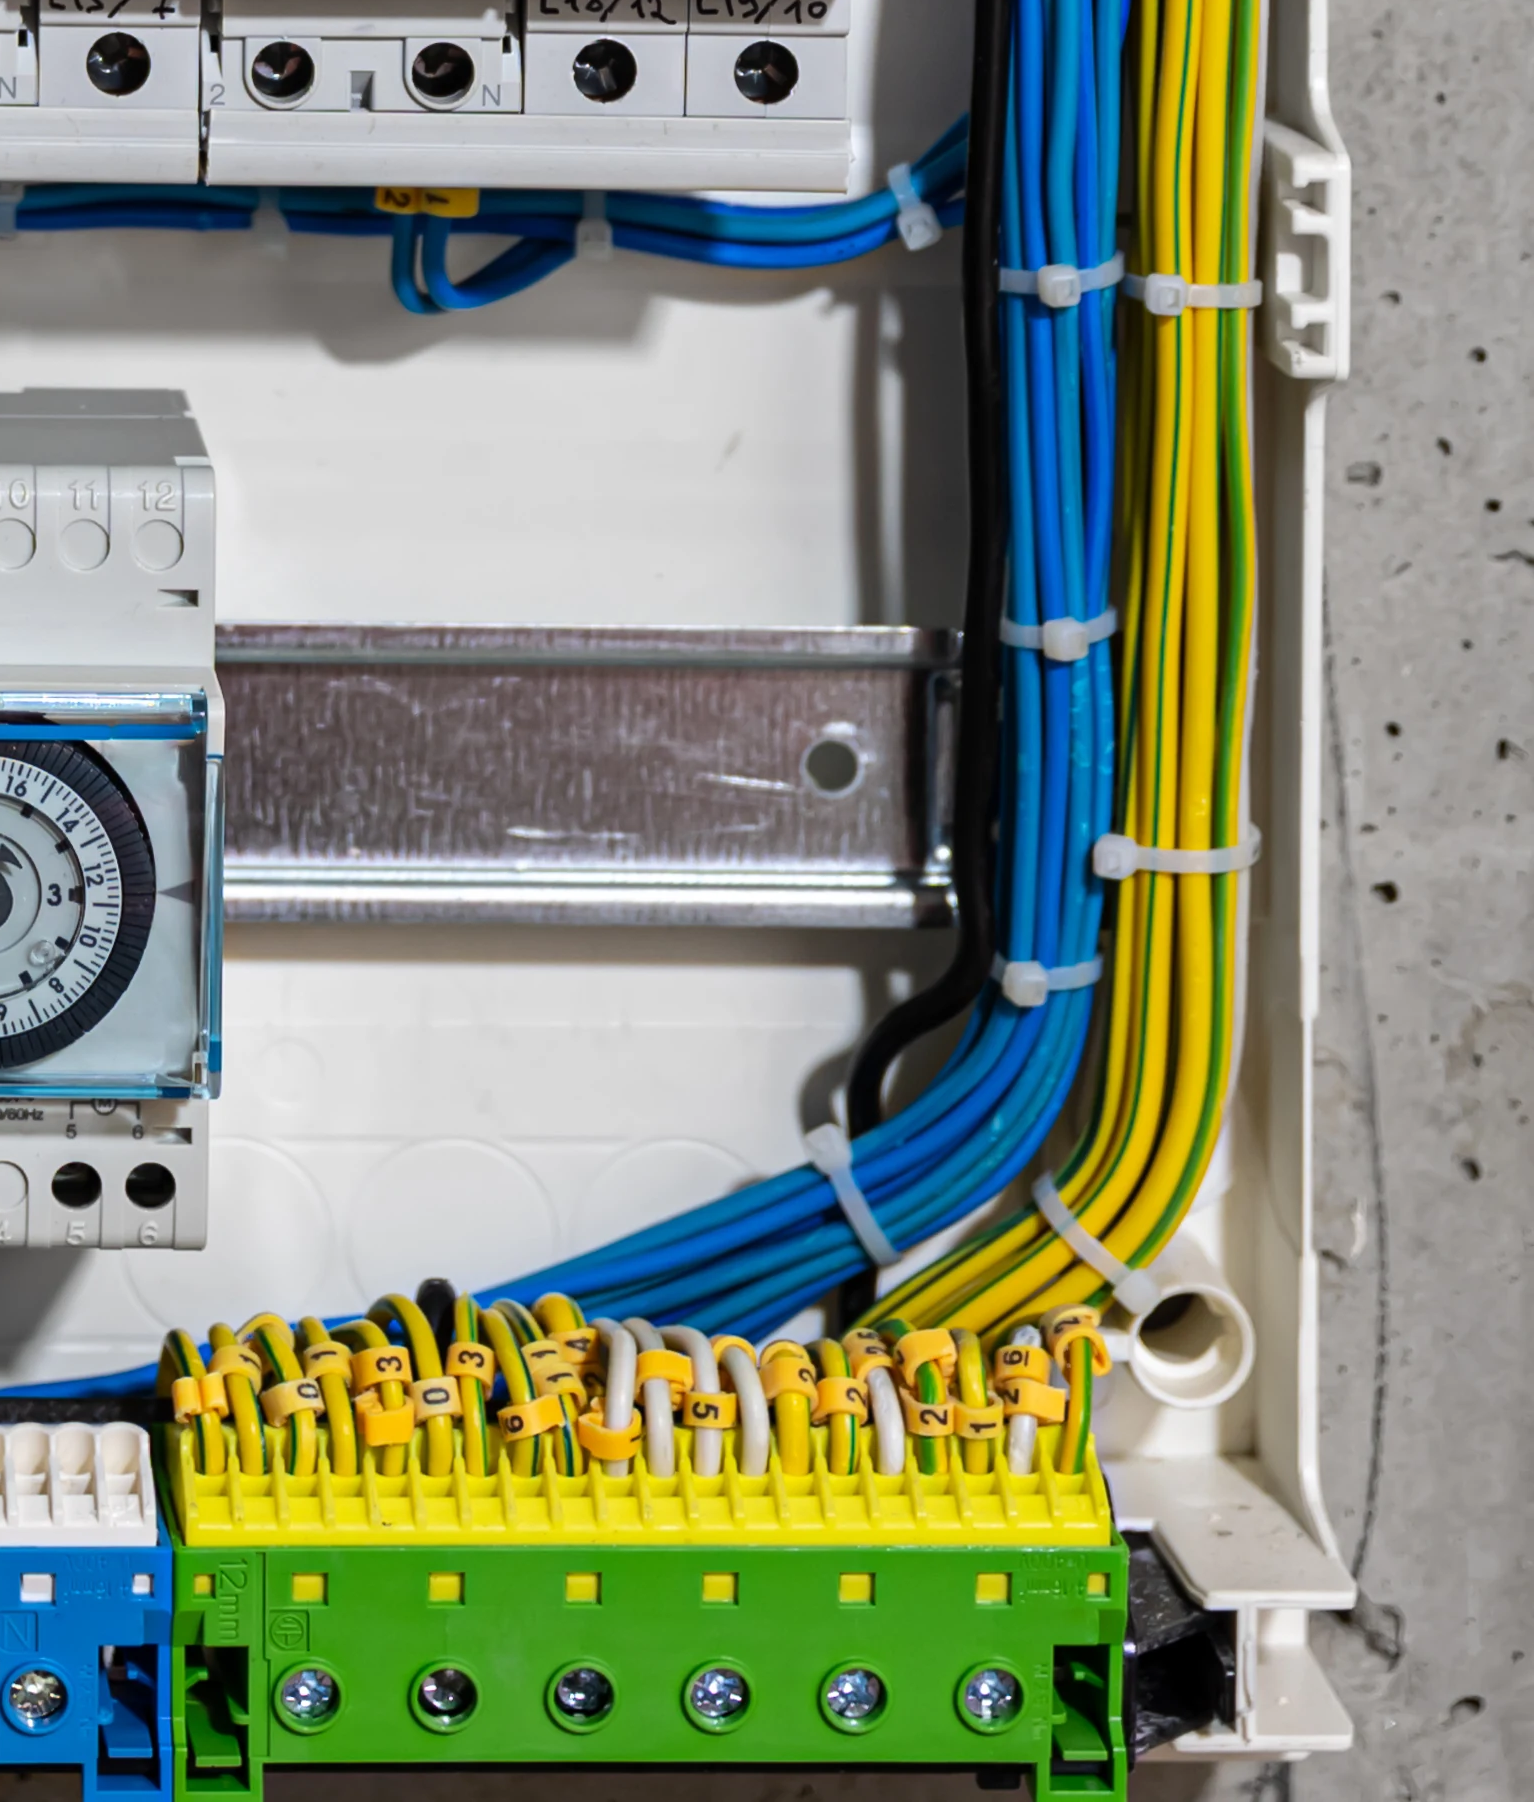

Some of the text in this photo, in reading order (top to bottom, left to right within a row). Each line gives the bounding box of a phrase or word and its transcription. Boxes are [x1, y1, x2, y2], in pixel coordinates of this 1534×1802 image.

[210, 84, 226, 106] 2
[482, 84, 501, 105] N
[71, 480, 100, 511] 11
[138, 480, 177, 511] 12
[4, 775, 28, 798] 16
[46, 884, 63, 907] 3
[215, 1557, 249, 1642] 12mm
